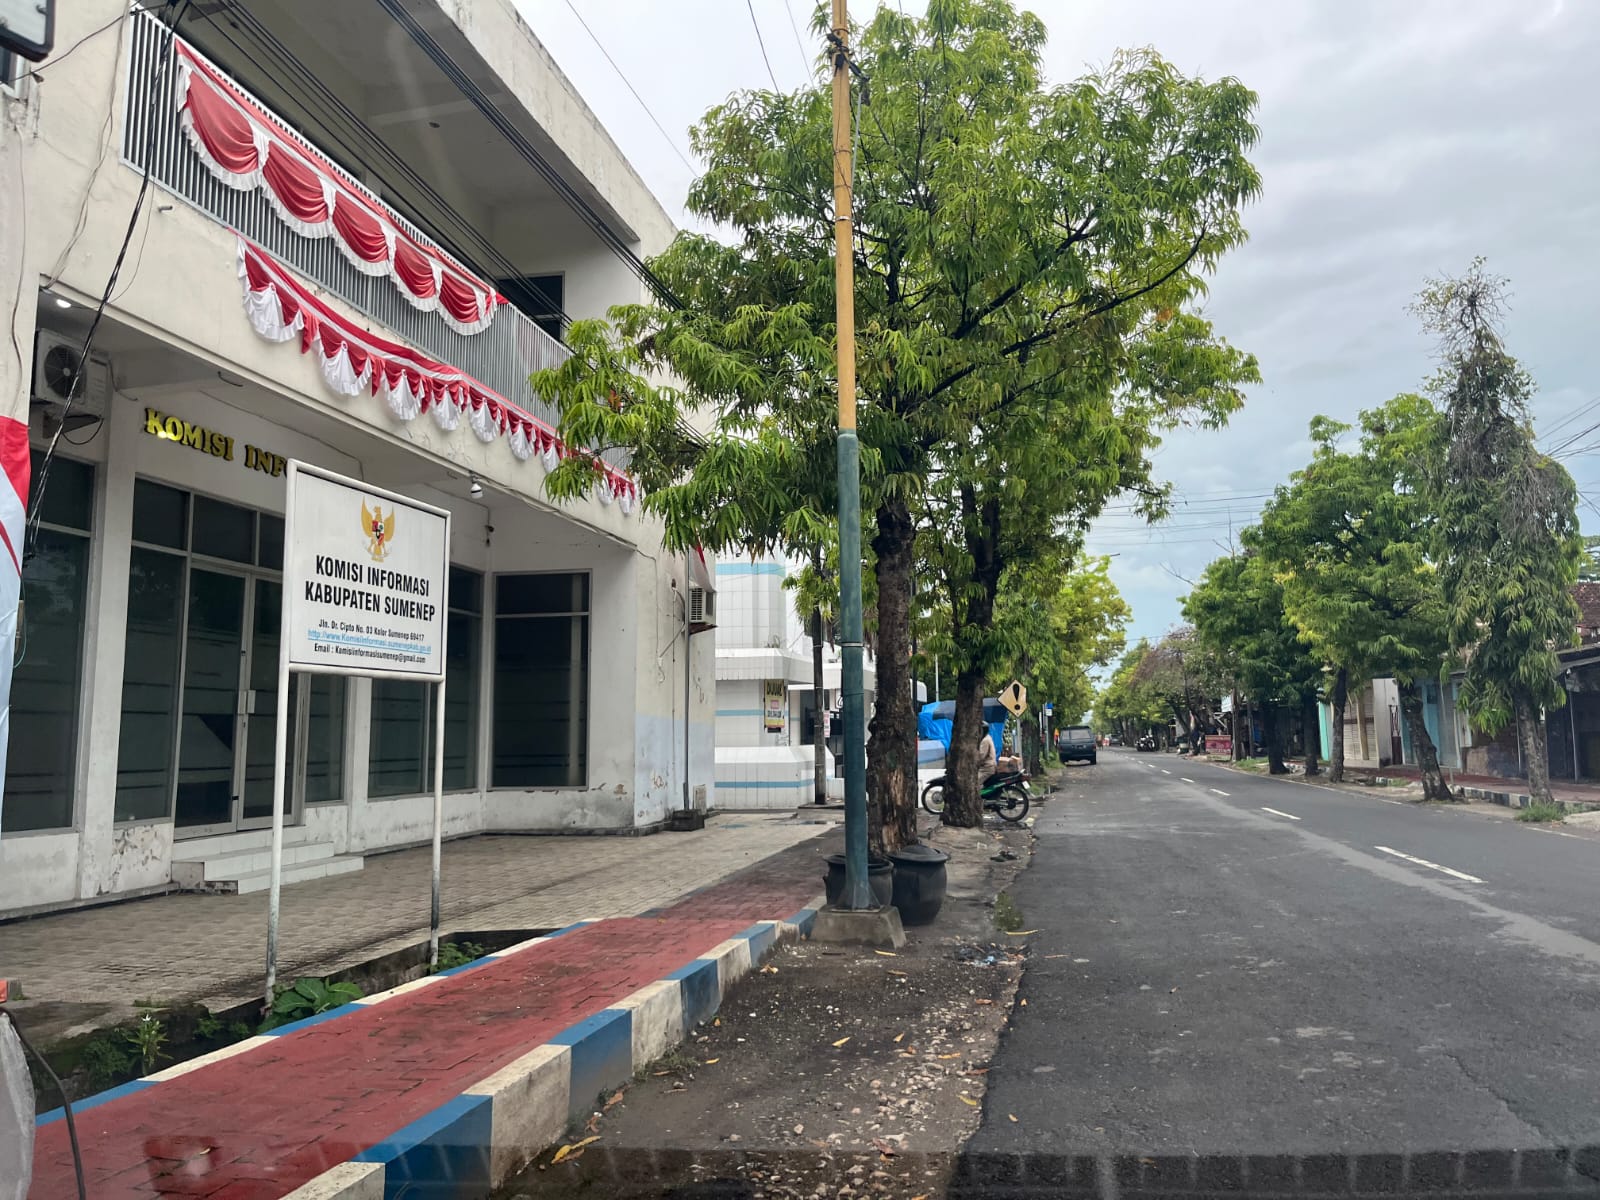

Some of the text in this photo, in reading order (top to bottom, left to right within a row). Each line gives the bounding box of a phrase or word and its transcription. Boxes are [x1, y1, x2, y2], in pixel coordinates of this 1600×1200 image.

[144, 407, 287, 478] KOMISI INF
[316, 555, 429, 597] KOMISI INFORMASI
[305, 580, 435, 622] KABUPATEN SUMENEP
[314, 642, 330, 653] Email
[340, 621, 355, 632] Cipto
[388, 628, 410, 640] Sumenep
